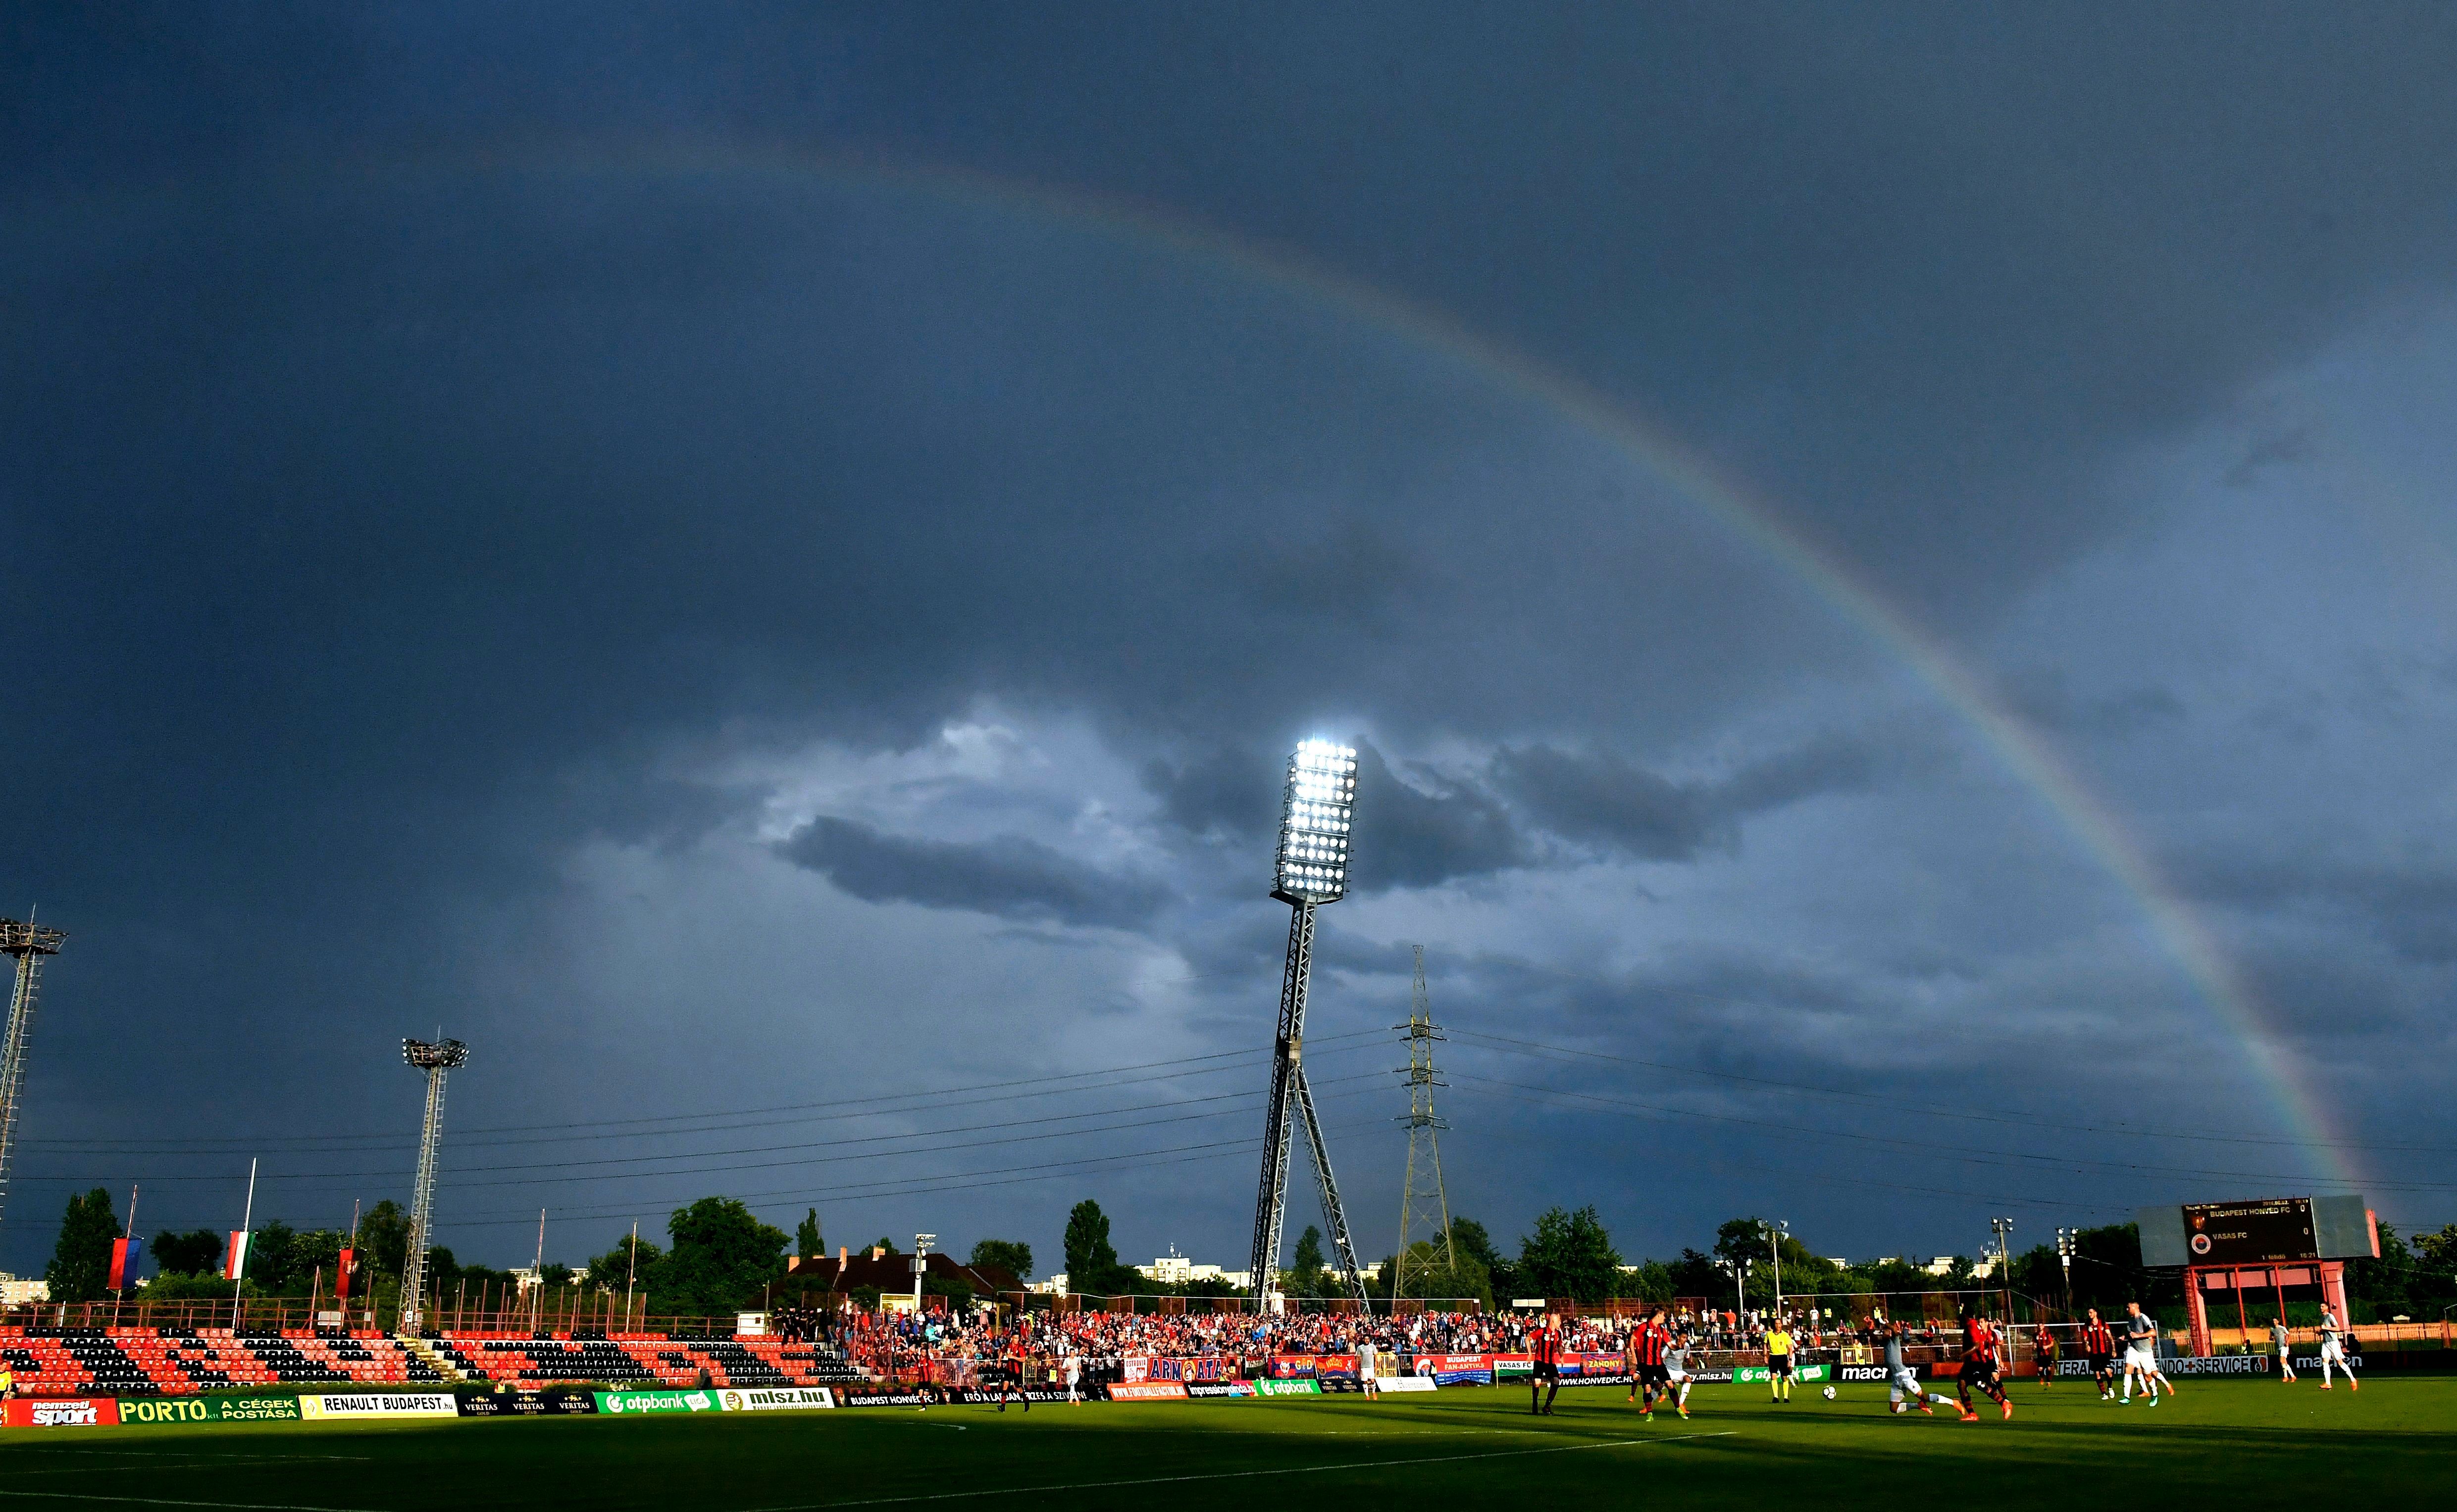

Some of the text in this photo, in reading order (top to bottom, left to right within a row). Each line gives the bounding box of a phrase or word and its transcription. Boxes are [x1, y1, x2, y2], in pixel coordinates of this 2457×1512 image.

[1842, 1367, 1916, 1380] macrn
[1275, 1380, 1313, 1395] otpbank
[626, 1393, 684, 1413] otpbank
[749, 1390, 825, 1404] mlsz.hu
[851, 1396, 888, 1405] BUDAPEST
[982, 1393, 990, 1402] A
[32, 1400, 90, 1410] nemzeti
[221, 1399, 296, 1409] A CÉGEK
[324, 1397, 379, 1411] RENAULT
[32, 1407, 98, 1426] sport
[119, 1400, 206, 1422] PORTÓ
[223, 1409, 297, 1419] POSTÁSA
